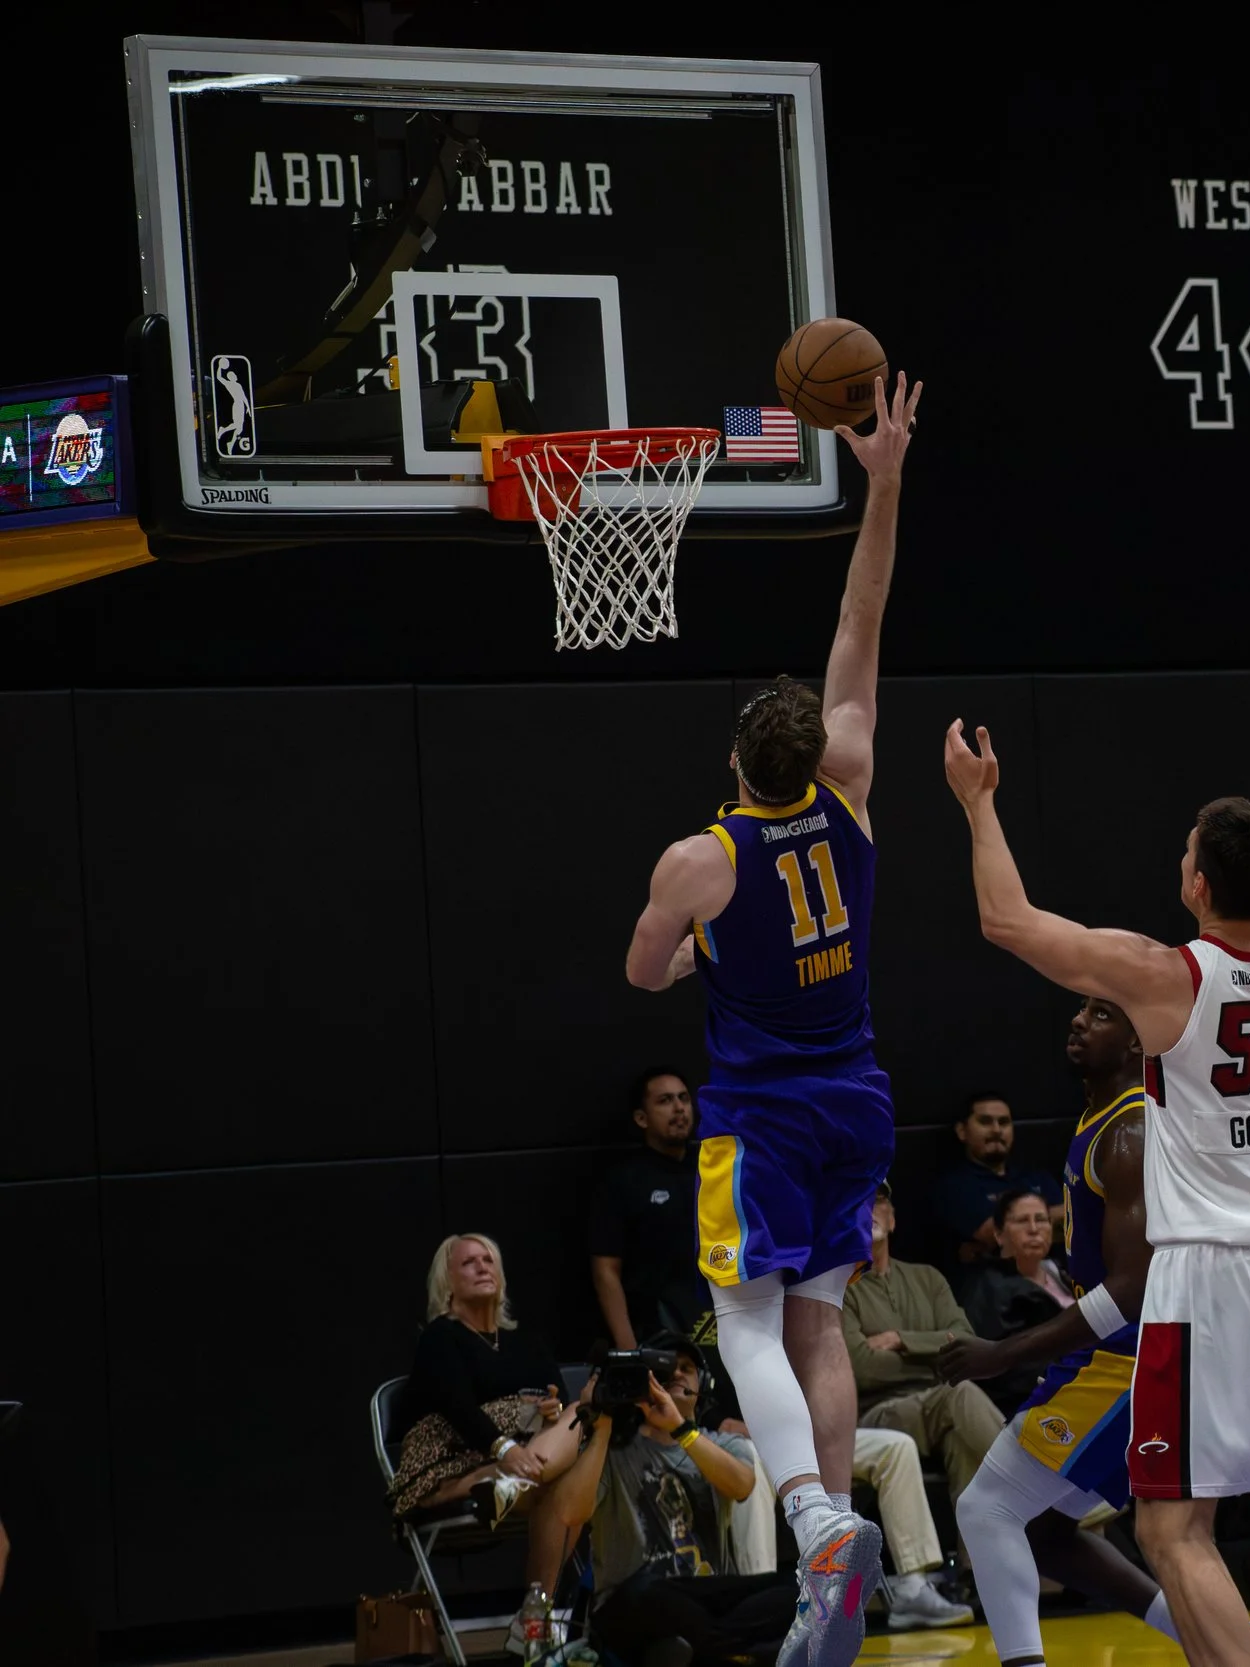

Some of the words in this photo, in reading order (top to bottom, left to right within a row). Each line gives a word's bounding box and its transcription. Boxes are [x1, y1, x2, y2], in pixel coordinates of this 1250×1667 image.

[201, 487, 269, 505] SPALDING
[775, 839, 850, 948] 11
[795, 940, 853, 988] TIMME
